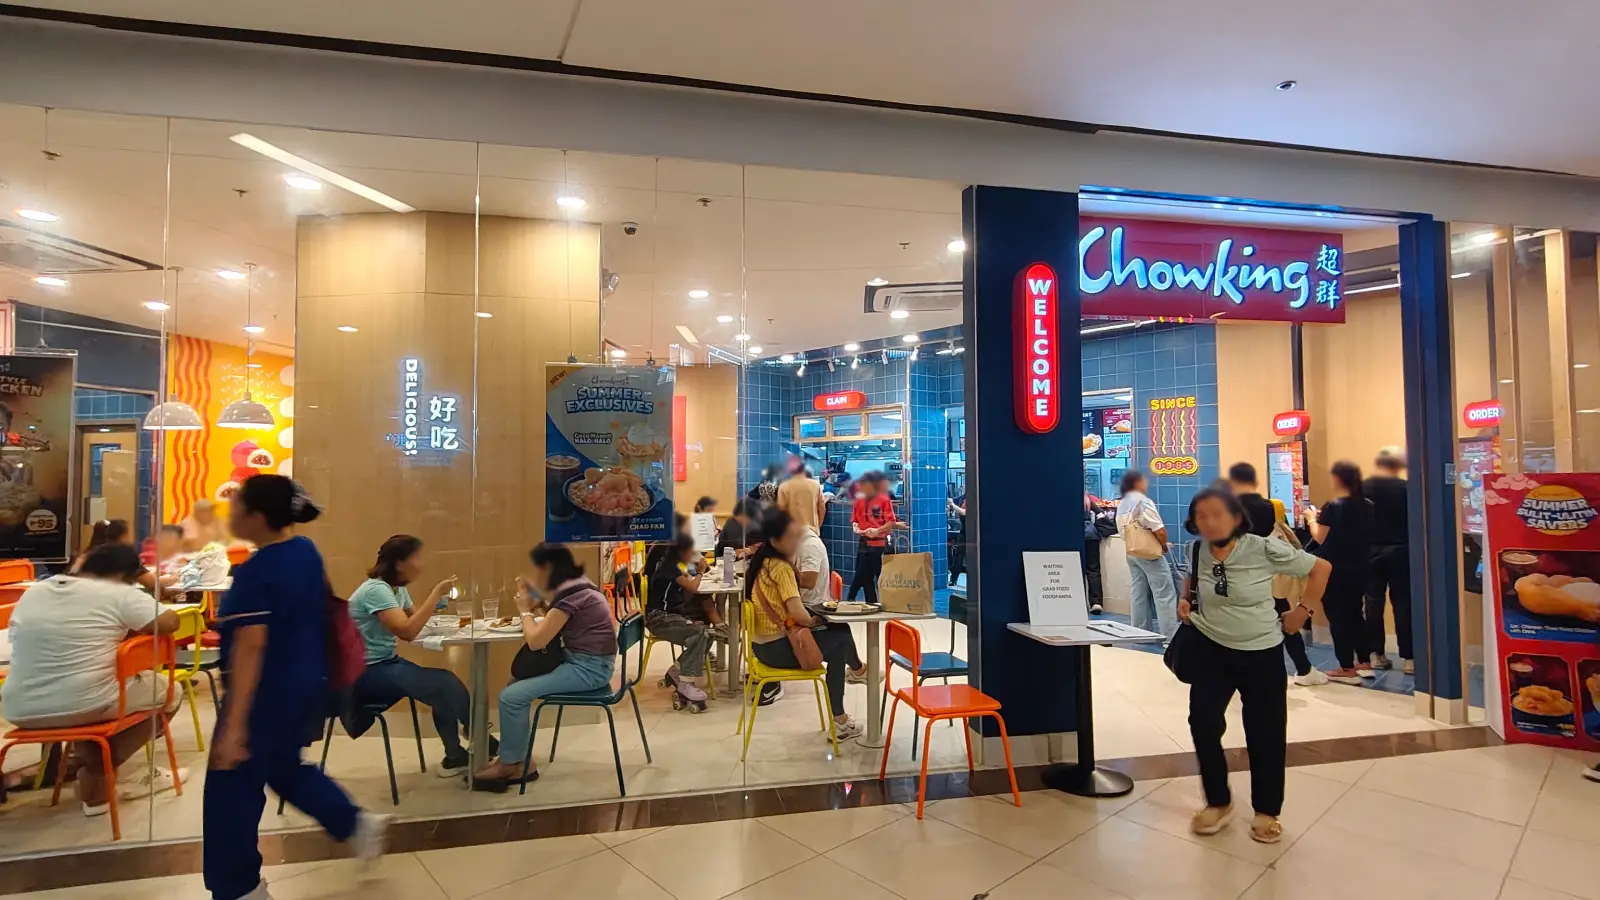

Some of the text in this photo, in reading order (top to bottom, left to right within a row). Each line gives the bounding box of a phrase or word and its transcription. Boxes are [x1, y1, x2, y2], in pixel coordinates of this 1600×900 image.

[1079, 226, 1310, 309] Chowking
[1028, 278, 1052, 416] WELCOME
[549, 371, 568, 386] NEW!
[577, 387, 642, 401] SUMMER
[826, 396, 848, 406] CLAIM
[405, 359, 418, 456] DELICIOUS!
[566, 399, 653, 414] EXCLUSIVES
[1150, 397, 1195, 411] SINCE
[1469, 407, 1500, 420] ORDER
[429, 396, 459, 449] 好吃
[1277, 418, 1298, 429] ORDER
[1522, 499, 1589, 511] SUMMER
[1525, 518, 1589, 530] SAVERS
